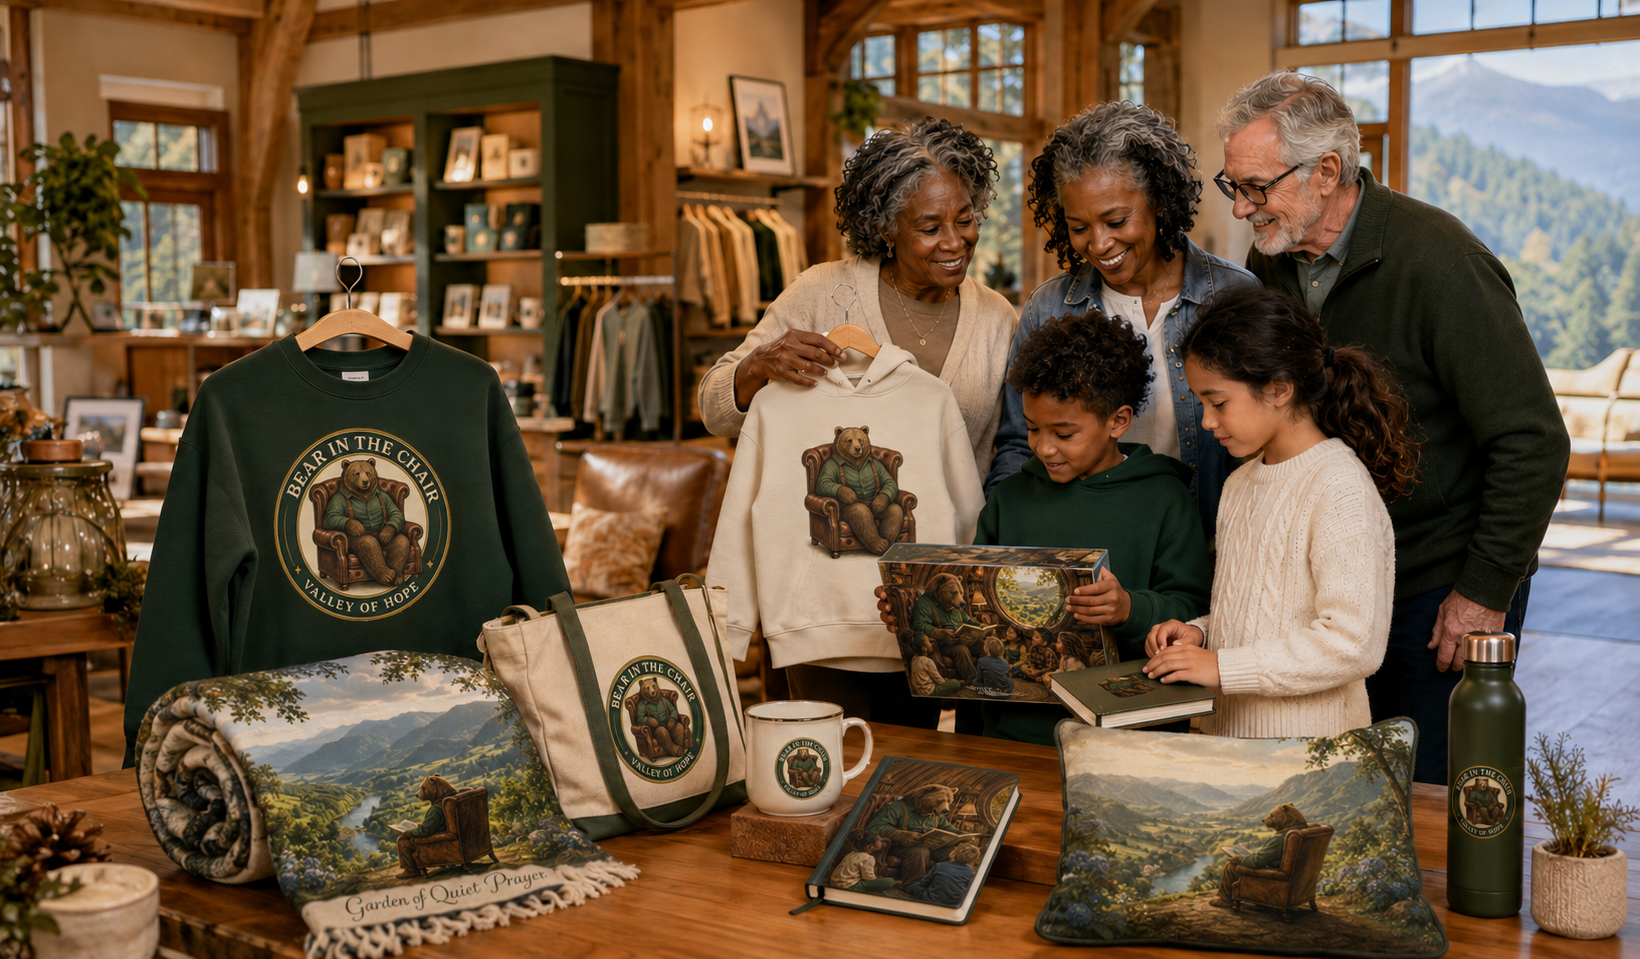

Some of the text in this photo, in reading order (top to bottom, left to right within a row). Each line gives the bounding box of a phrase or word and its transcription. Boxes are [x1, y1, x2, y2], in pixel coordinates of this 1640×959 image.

[286, 435, 439, 504] BEAR IN THE CHAIR
[303, 579, 419, 613] VALLEY OF HOPE
[611, 661, 696, 709] BEAR IN THE CHAIR
[631, 757, 661, 778] VALLEY
[345, 870, 548, 922] Garden of Quiet Prayer
